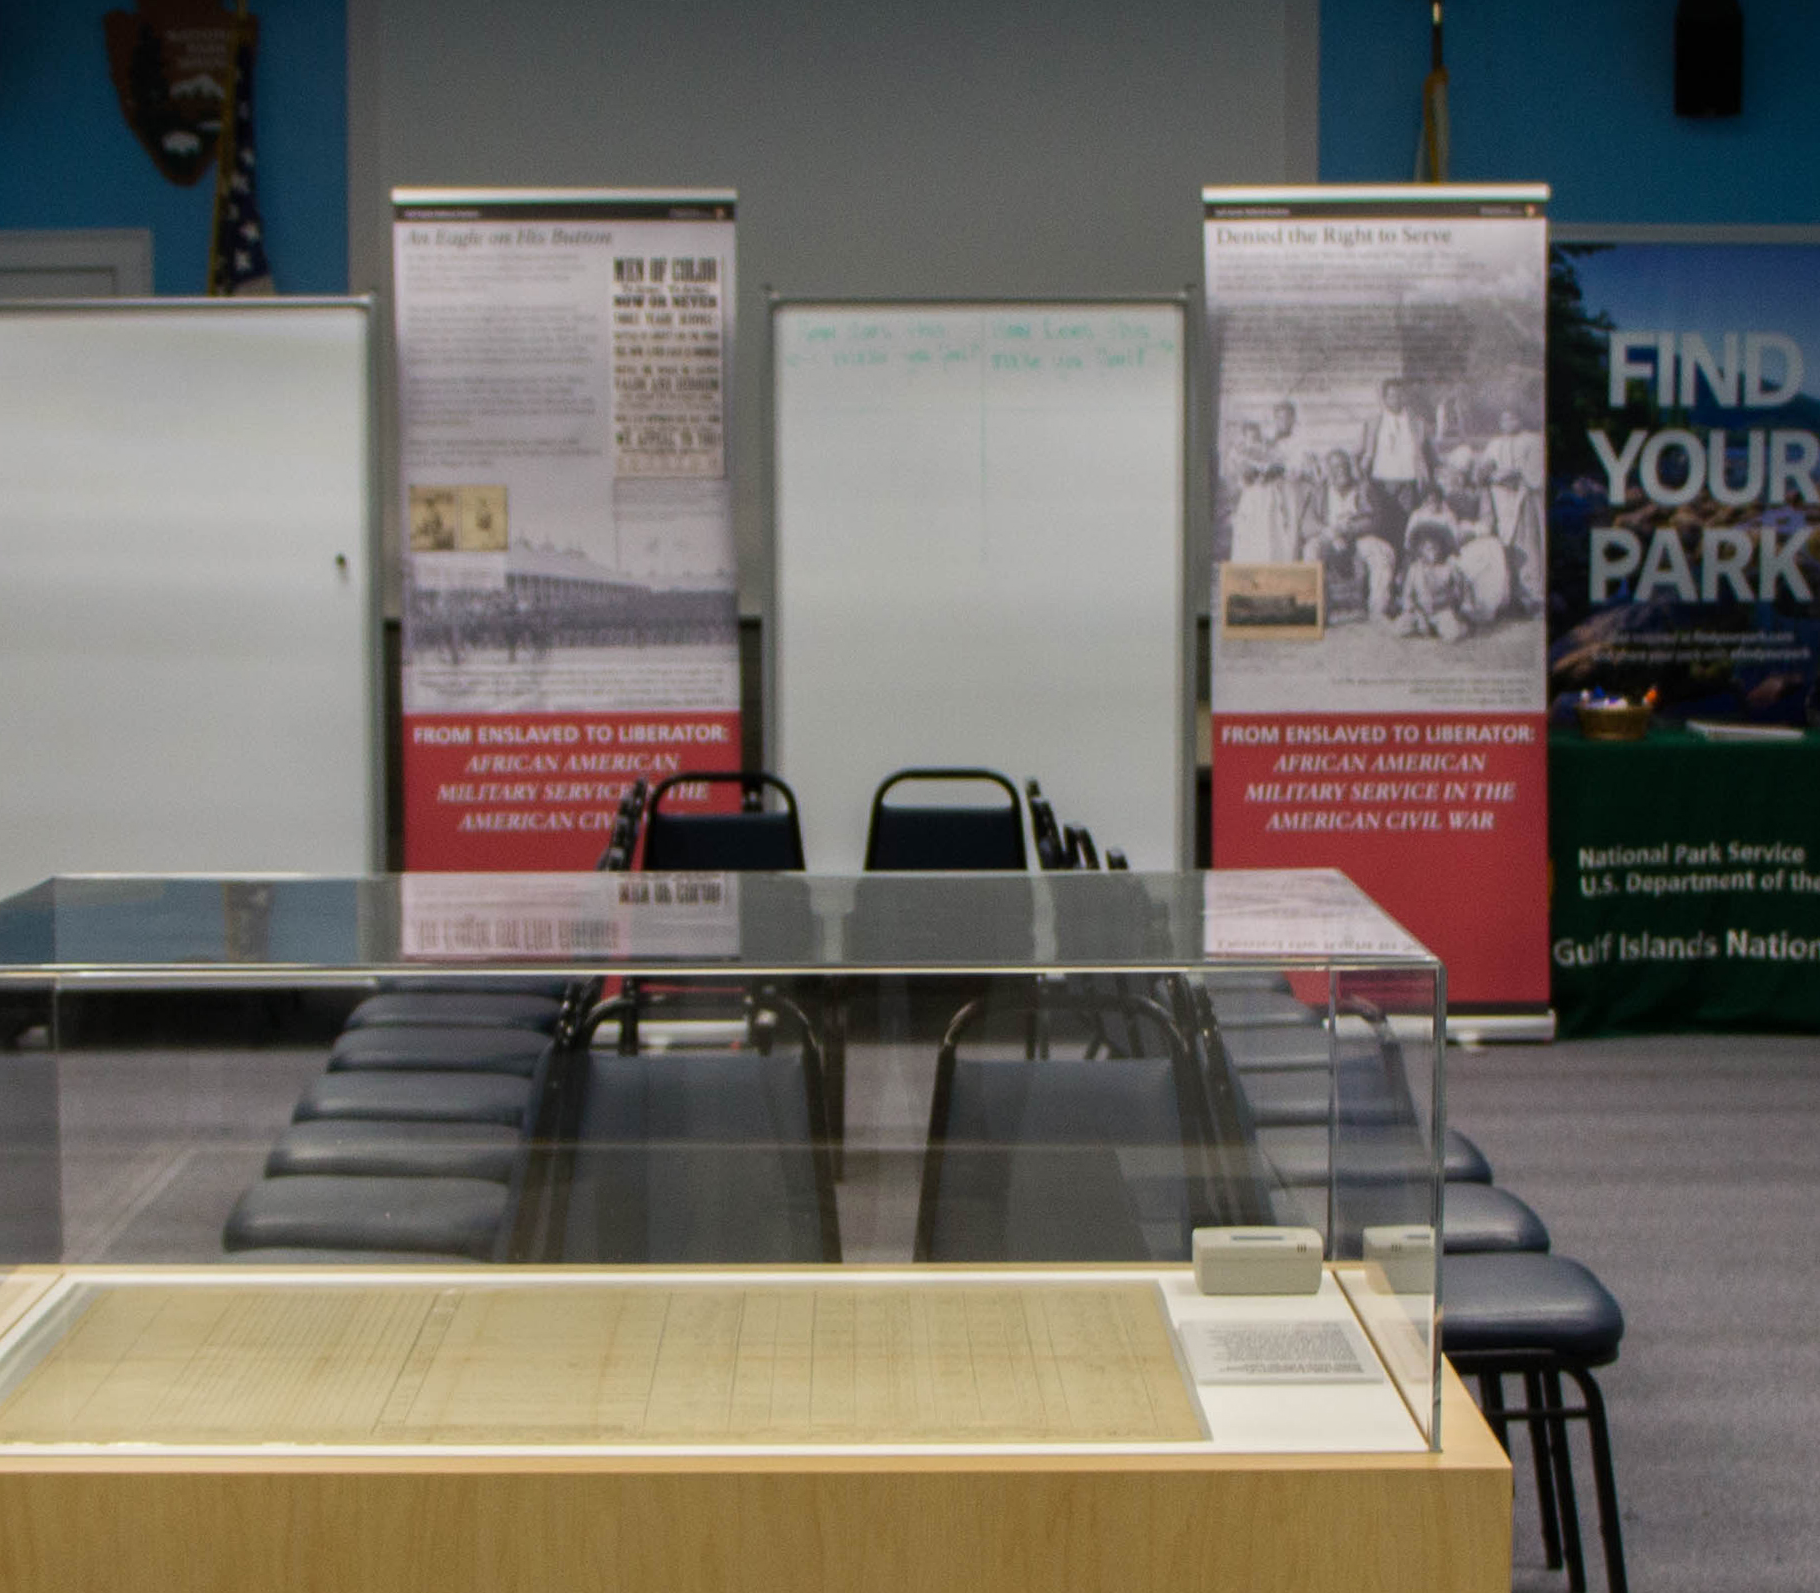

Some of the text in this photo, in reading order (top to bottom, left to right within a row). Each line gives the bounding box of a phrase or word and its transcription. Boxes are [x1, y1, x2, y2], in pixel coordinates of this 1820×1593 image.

[406, 229, 613, 248] An Eagle on His Button
[1216, 228, 1452, 248] Denied the Right to Serve
[614, 257, 644, 282] MEN
[650, 257, 667, 282] OF
[672, 257, 717, 282] COLOR
[1607, 332, 1805, 408] FIND
[1589, 527, 1814, 603] PARK
[413, 725, 729, 744] FROM ENSLAVED TO LIBERATOR:
[1222, 725, 1535, 744] FROM ENSLAVED TO LIBERATOR:
[465, 754, 680, 773] AFRICAN AMERICAN
[1273, 754, 1486, 773] AFRICAN AMERICAN
[437, 783, 539, 802] MILITARY
[1244, 783, 1516, 802] MILITARY SERVICE IN THE
[459, 813, 616, 831] AMERICAN CIV
[1266, 812, 1495, 831] AMERICAN CIVIL WAR
[1578, 840, 1806, 870] National Park Service
[1580, 875, 1620, 897] U.S.
[1625, 871, 1755, 896] Department
[1761, 869, 1785, 892] of
[1553, 935, 1612, 968] Gulf
[1618, 932, 1718, 961] Islands
